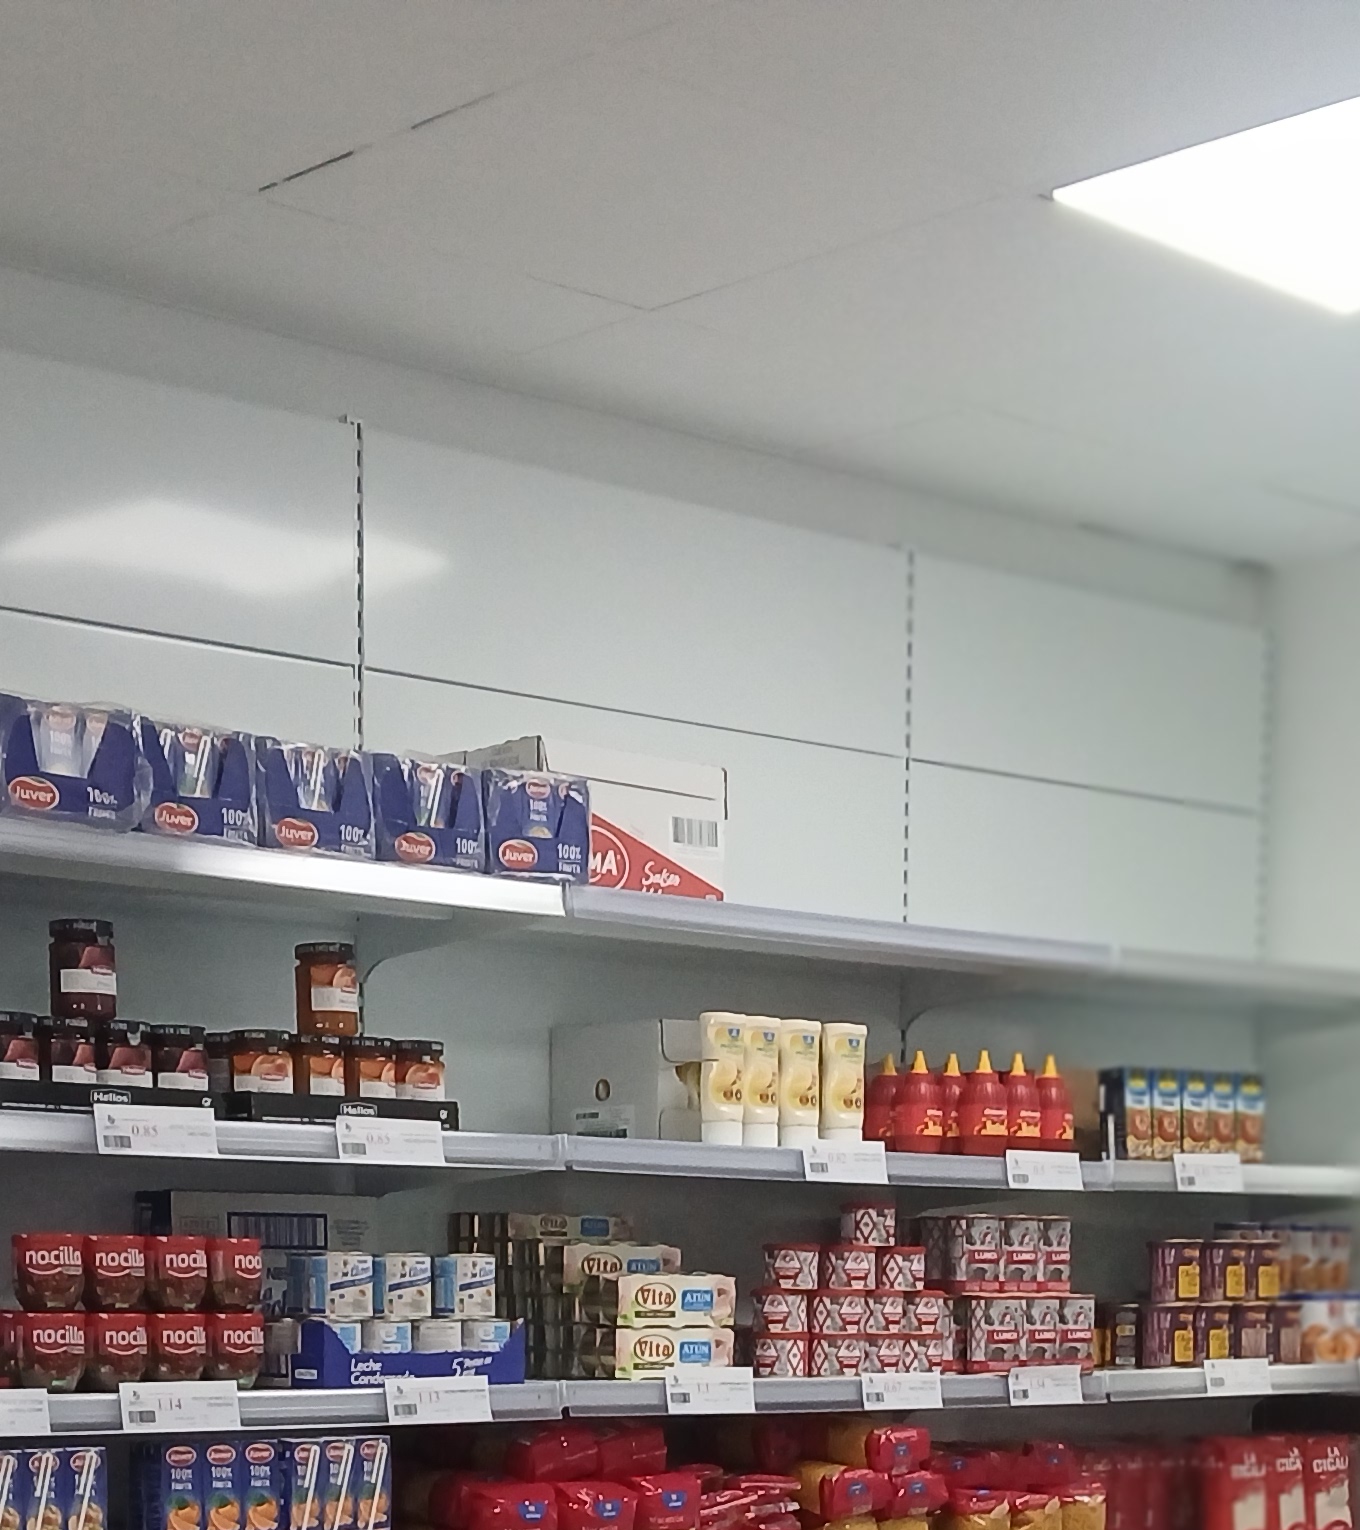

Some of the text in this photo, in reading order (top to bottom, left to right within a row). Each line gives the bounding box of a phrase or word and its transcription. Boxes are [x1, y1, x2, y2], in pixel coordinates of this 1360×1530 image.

[14, 786, 53, 804] Juver
[159, 809, 193, 826] Juver
[280, 827, 313, 842] Juver
[504, 849, 534, 863] Juver
[557, 843, 581, 860] 100%
[131, 1123, 159, 1137] 0.85
[25, 1246, 82, 1265] nocilla
[638, 1286, 673, 1307] Vita
[33, 1325, 84, 1345] nocilla
[637, 1338, 672, 1359] Vita
[350, 1359, 382, 1372] Leche
[1327, 1447, 1340, 1457] LA
